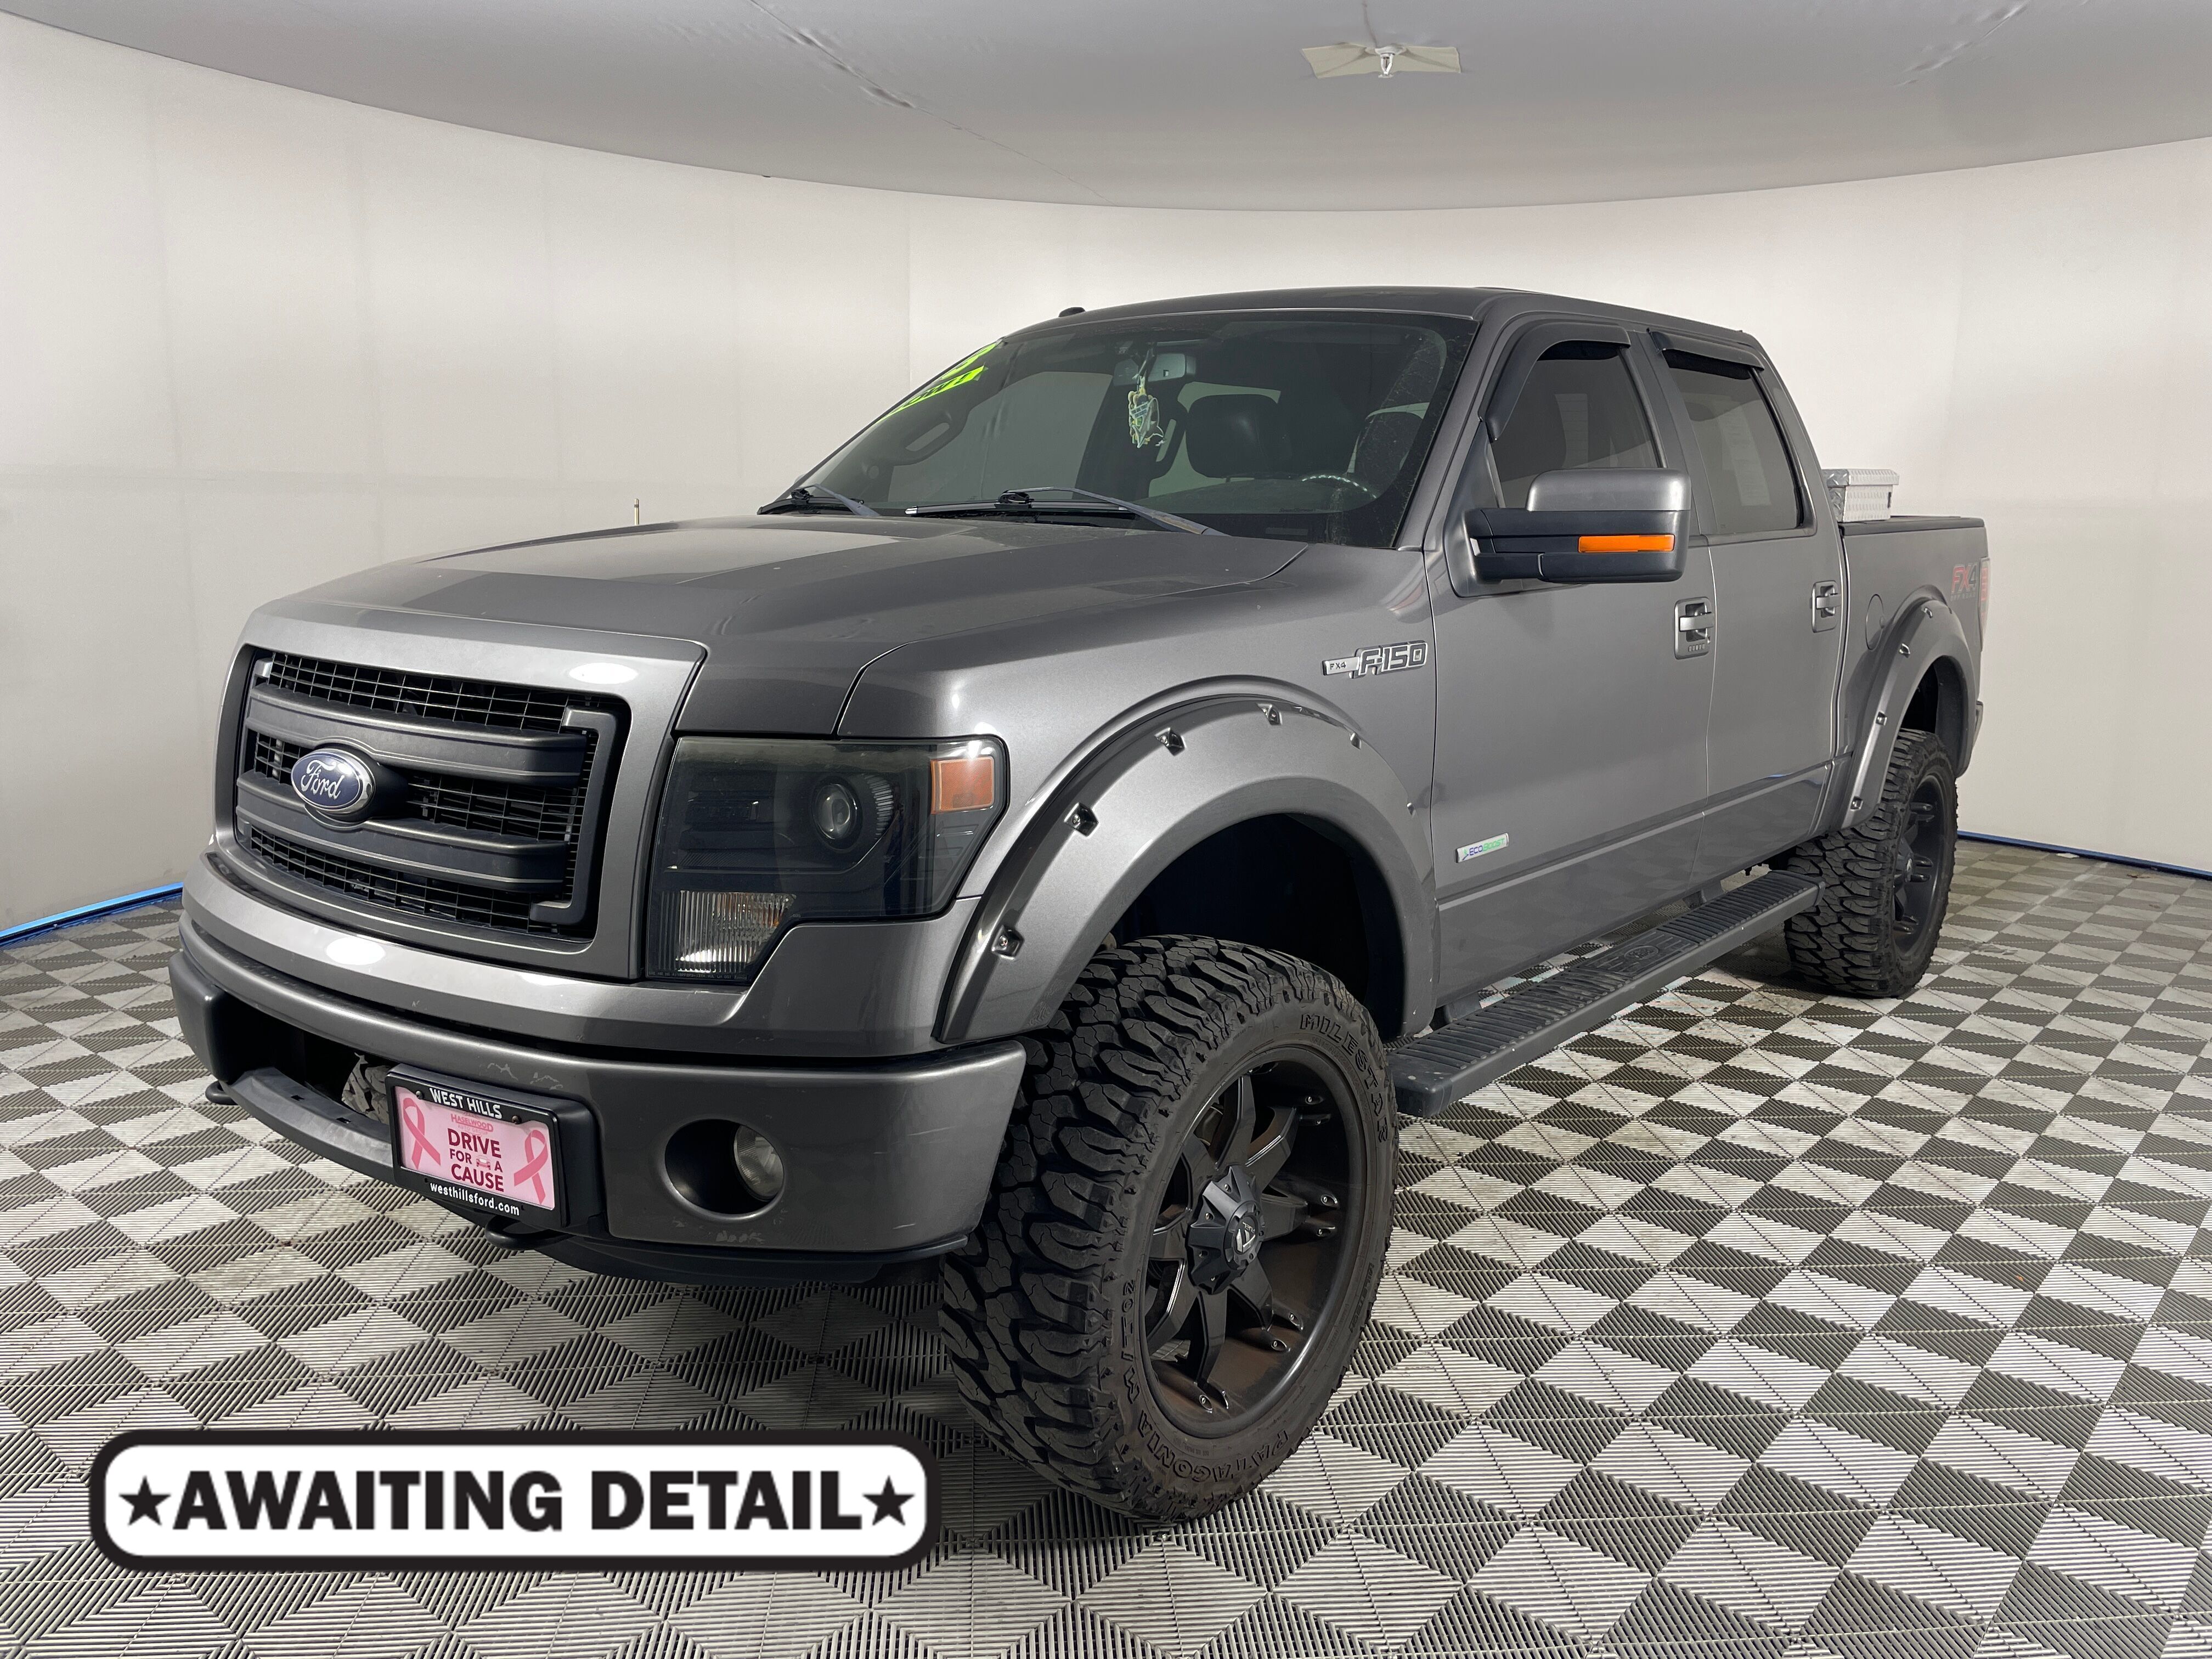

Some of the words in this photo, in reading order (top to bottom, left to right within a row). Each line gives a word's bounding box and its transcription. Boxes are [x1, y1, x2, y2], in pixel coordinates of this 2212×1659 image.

[1951, 564, 1977, 592] FX4
[1330, 661, 1346, 671] FX4
[301, 759, 345, 800] Ford
[1300, 1014, 1388, 1143] MILESTAR
[429, 1088, 462, 1108] WEST
[467, 1098, 503, 1119] HILLS
[450, 1114, 494, 1132] HASELWOOD
[448, 1128, 501, 1158] DRIVE
[449, 1149, 472, 1164] FOR
[494, 1161, 503, 1172] A
[451, 1164, 504, 1192] CAUSE
[430, 1182, 520, 1216] westhillsford.com
[1138, 1409, 1289, 1482] PATAGONIA
